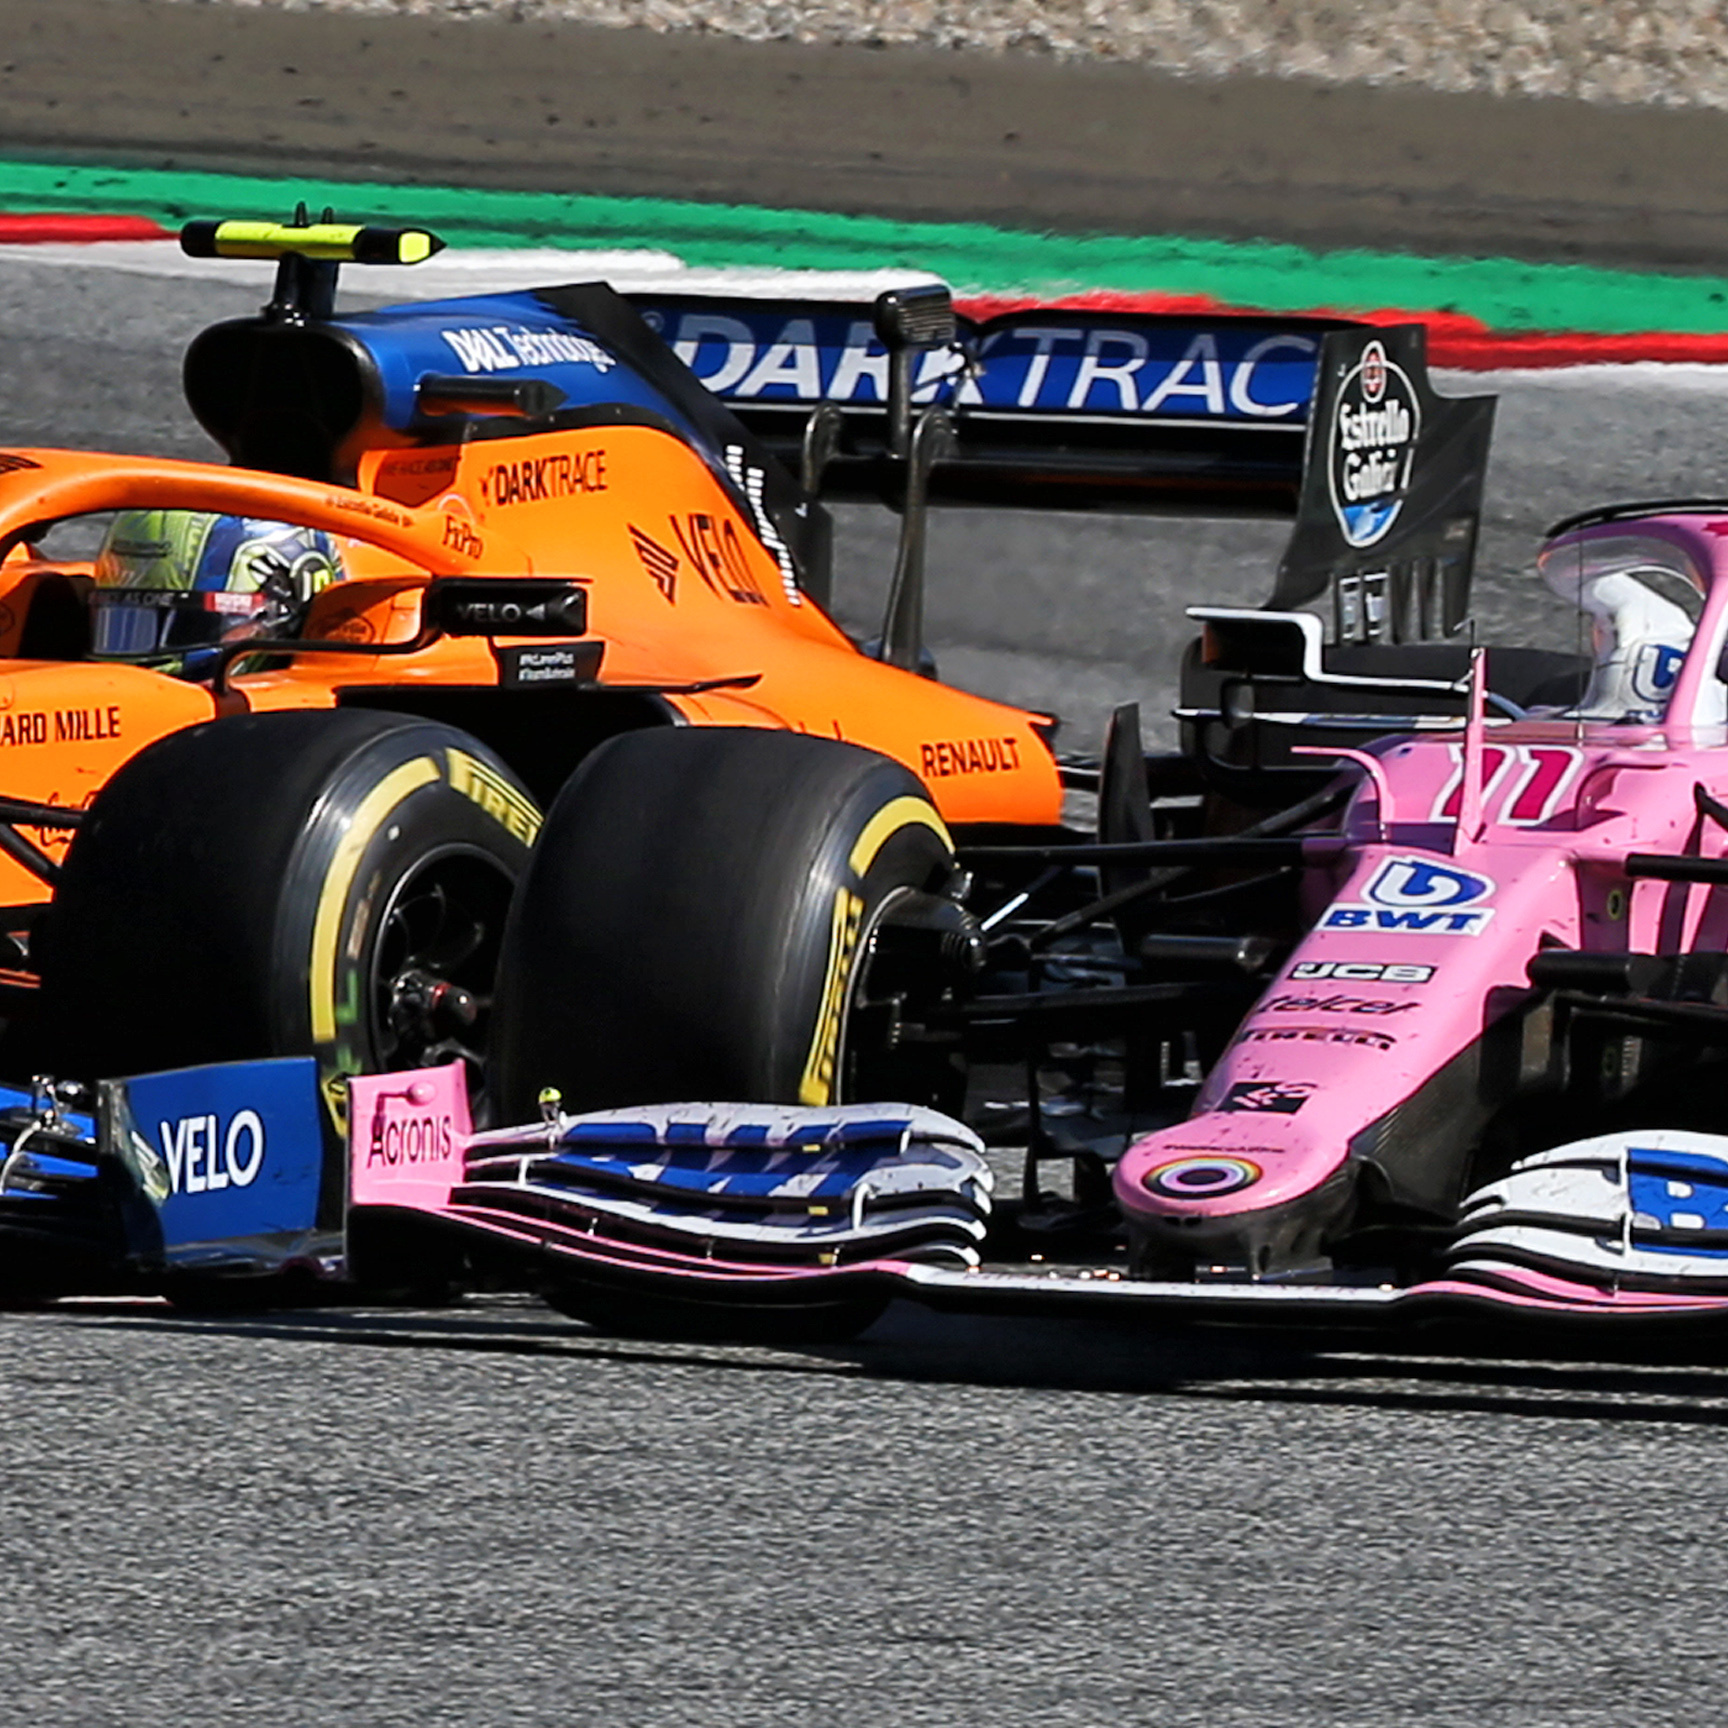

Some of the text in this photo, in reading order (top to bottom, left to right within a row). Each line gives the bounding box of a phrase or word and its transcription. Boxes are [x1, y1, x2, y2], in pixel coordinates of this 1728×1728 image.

[674, 314, 1317, 416] DARKTRAC
[495, 450, 608, 506] DARKTRACE
[458, 602, 522, 623] VELO
[54, 705, 122, 743] MILLE
[922, 737, 1021, 777] RENAULT
[1433, 744, 1582, 825] 11
[1322, 909, 1482, 931] BWT
[1291, 963, 1434, 983] JCB
[161, 1109, 266, 1194] VELO
[368, 1110, 453, 1170] Acronis
